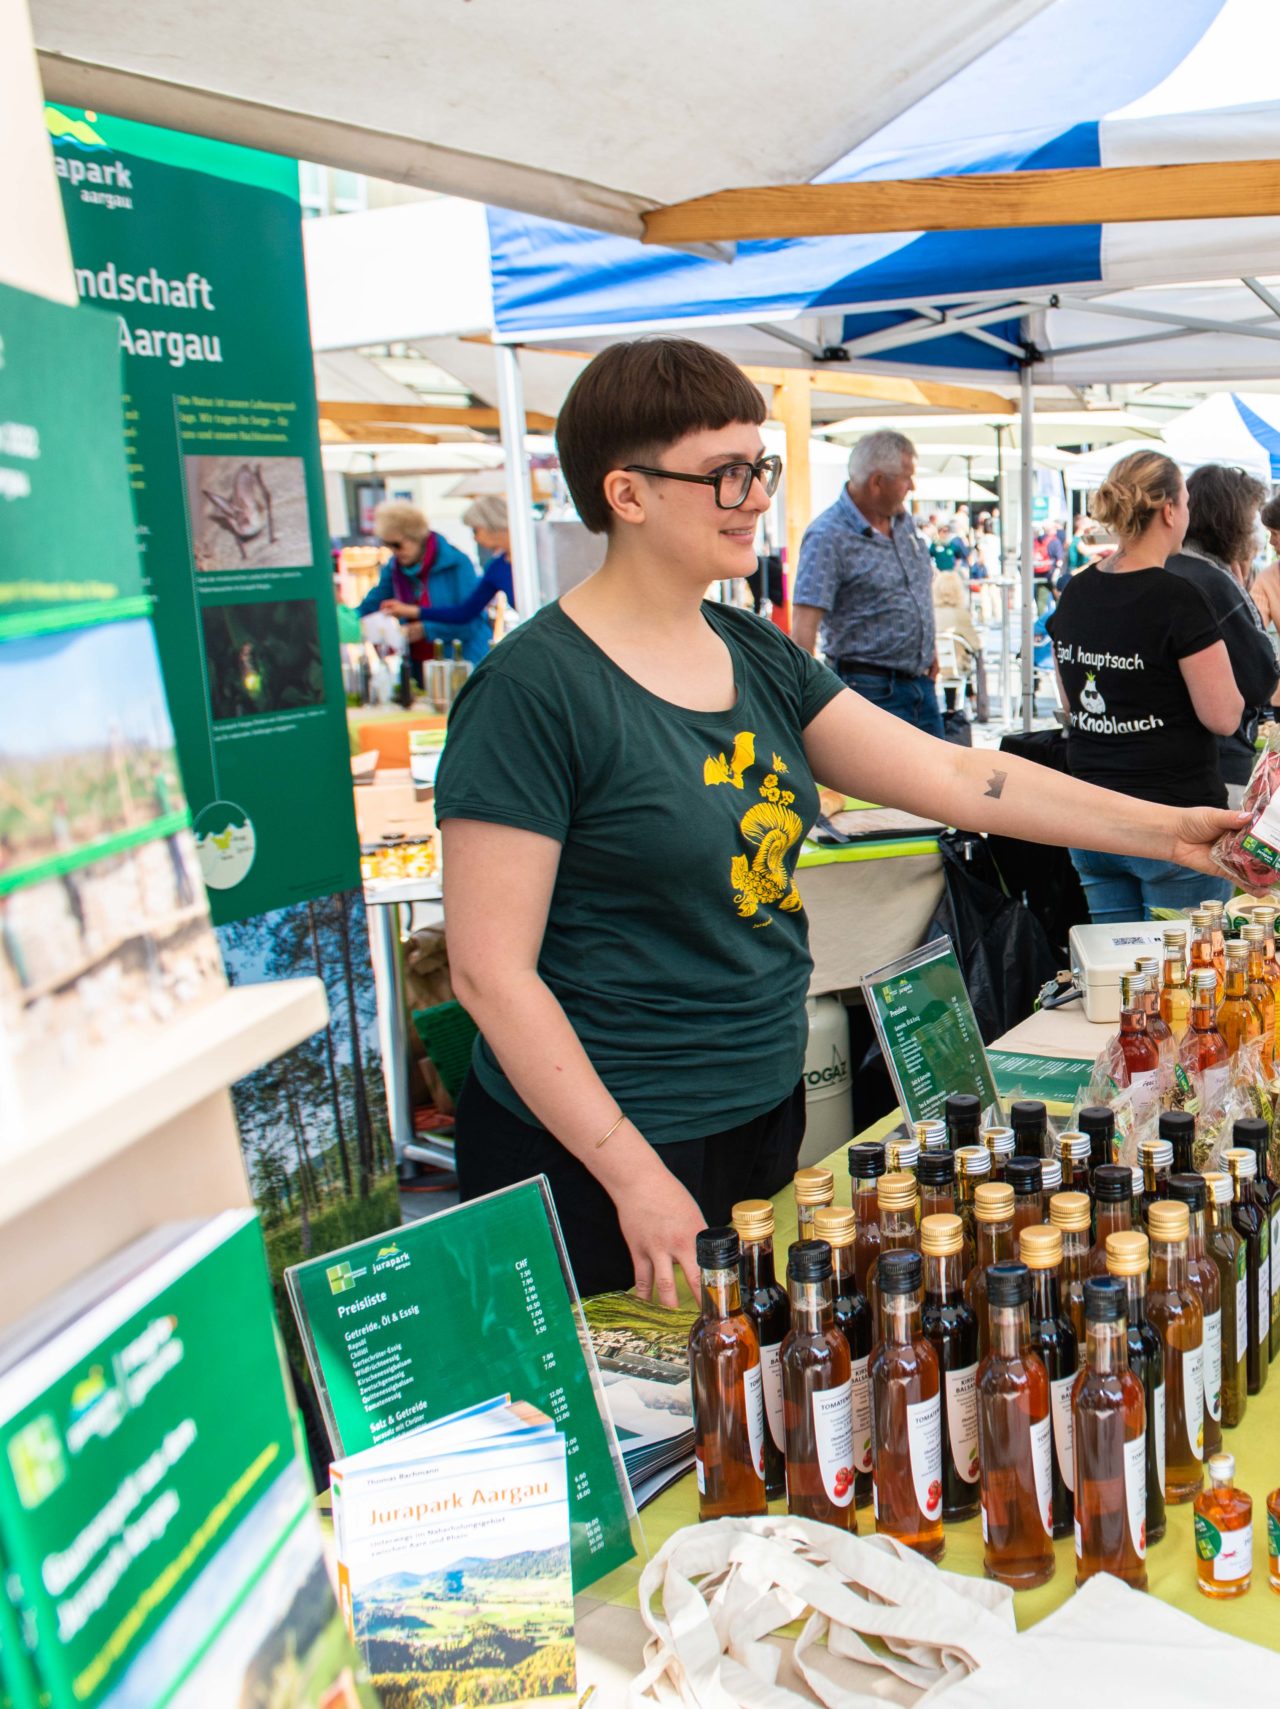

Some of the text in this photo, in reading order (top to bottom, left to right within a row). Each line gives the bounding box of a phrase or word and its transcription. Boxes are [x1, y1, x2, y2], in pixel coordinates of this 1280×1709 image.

[80, 188, 134, 210] aargau
[1077, 645, 1145, 671] hauptsach
[1078, 711, 1164, 735] Knoblauch
[515, 1258, 528, 1271] CHF
[337, 1291, 387, 1319] Preisliste
[344, 1305, 420, 1341] Getreide, Öl & Essig
[851, 1375, 868, 1384] BALSA
[855, 1368, 868, 1377] KIRS
[956, 1383, 976, 1394] BALSA
[364, 1391, 402, 1413] Tomatenessig
[821, 1396, 850, 1411] TOMATEN
[369, 1400, 428, 1434] Salz & Getreide
[371, 1482, 549, 1526] Jurapark Aargau
